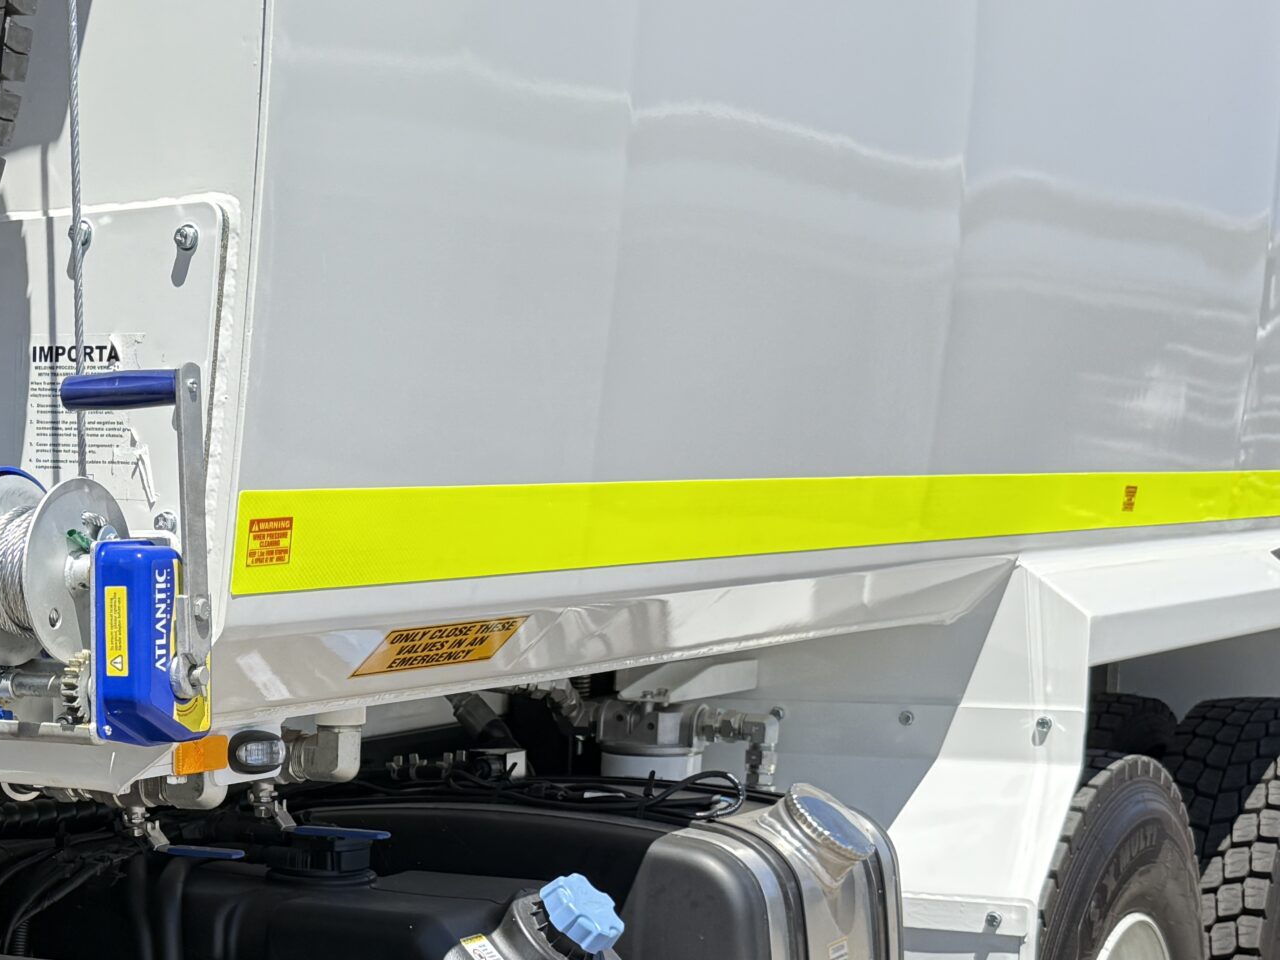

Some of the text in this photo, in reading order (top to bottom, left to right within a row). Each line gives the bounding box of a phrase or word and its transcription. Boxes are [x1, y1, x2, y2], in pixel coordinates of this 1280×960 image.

[260, 520, 290, 530] WARNING
[266, 531, 288, 540] PRESSURE
[155, 568, 167, 672] ATLANTIC
[389, 620, 519, 645] ONLY CLOSE THESE
[396, 635, 490, 656] VALVES IN AN
[386, 650, 474, 669] EMERGENCY
